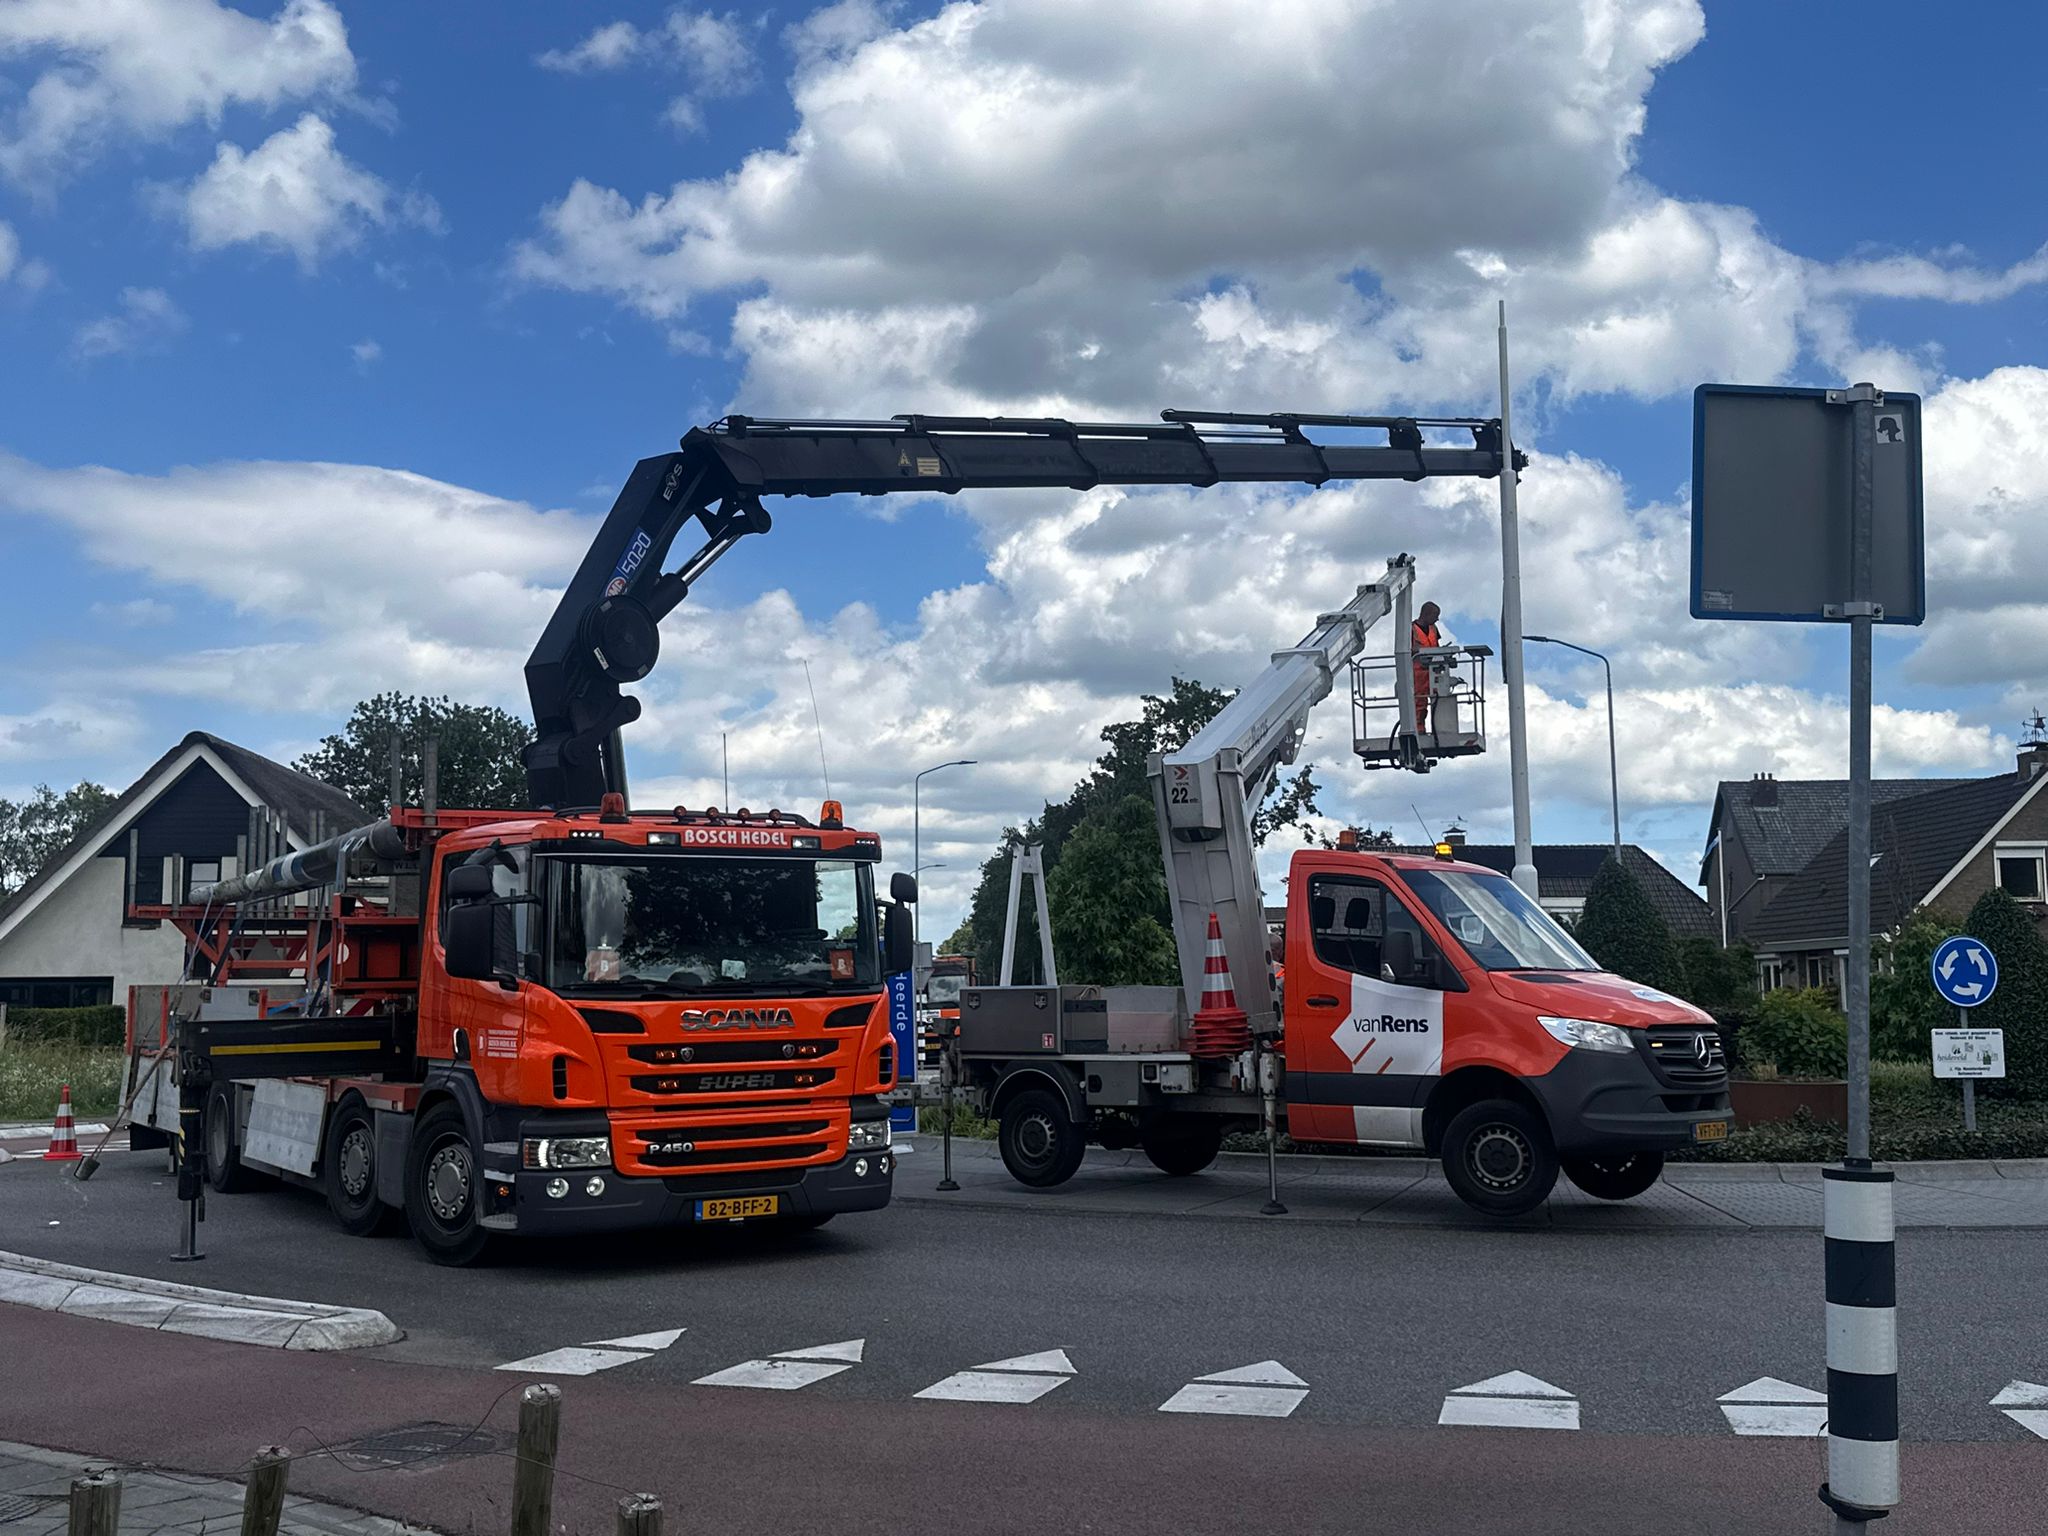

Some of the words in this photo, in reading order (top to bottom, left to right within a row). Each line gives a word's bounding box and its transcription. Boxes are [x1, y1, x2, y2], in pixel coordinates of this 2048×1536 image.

[663, 464, 683, 501] EVS
[621, 532, 652, 574] 5020
[1171, 787, 1189, 804] 22
[685, 829, 737, 844] BOSCH
[741, 831, 788, 846] HEDEL
[680, 1008, 796, 1031] SCANIA
[1353, 1014, 1429, 1033] vanRens
[698, 1074, 776, 1090] SUPER
[649, 1143, 660, 1154] P
[661, 1142, 693, 1153] 450
[708, 1198, 772, 1217] 82-BFF-2
